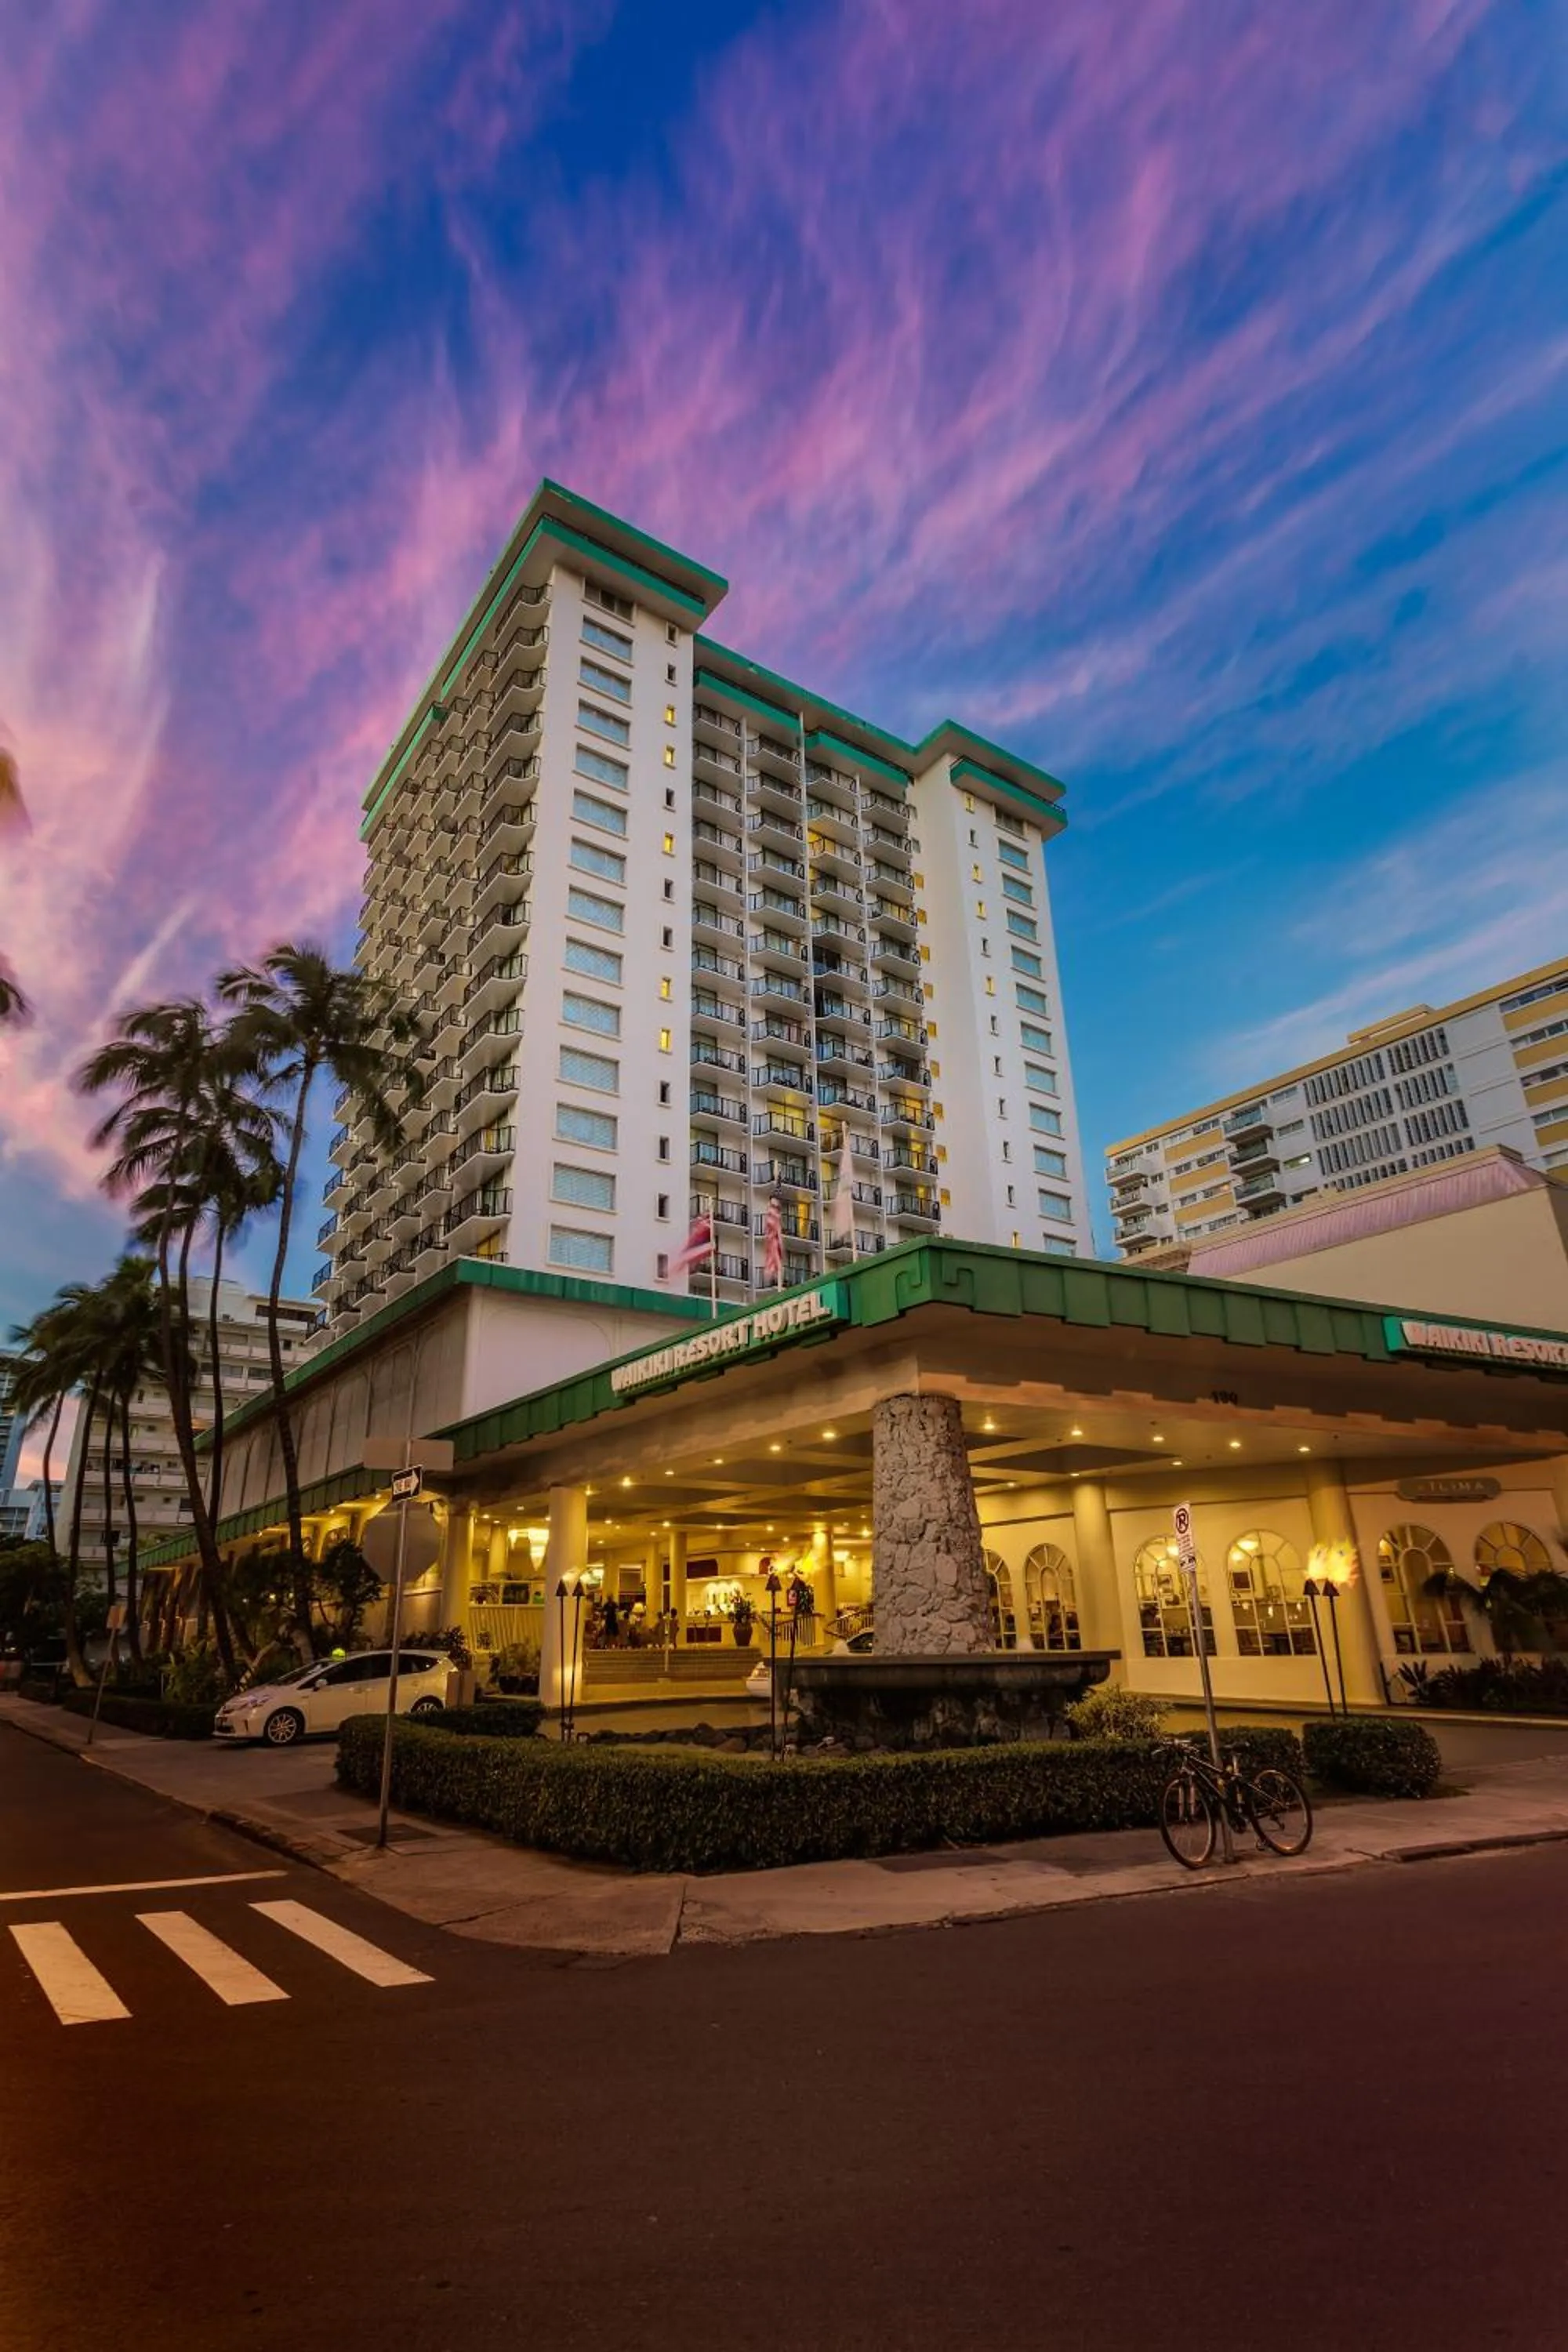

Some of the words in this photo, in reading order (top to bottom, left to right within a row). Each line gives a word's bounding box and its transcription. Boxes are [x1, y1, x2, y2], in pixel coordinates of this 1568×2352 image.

[612, 1347, 674, 1392] WAIKIKI
[674, 1318, 752, 1369] RESORT
[753, 1291, 830, 1339] HOTEL
[1402, 1320, 1490, 1355] WAIKIKI
